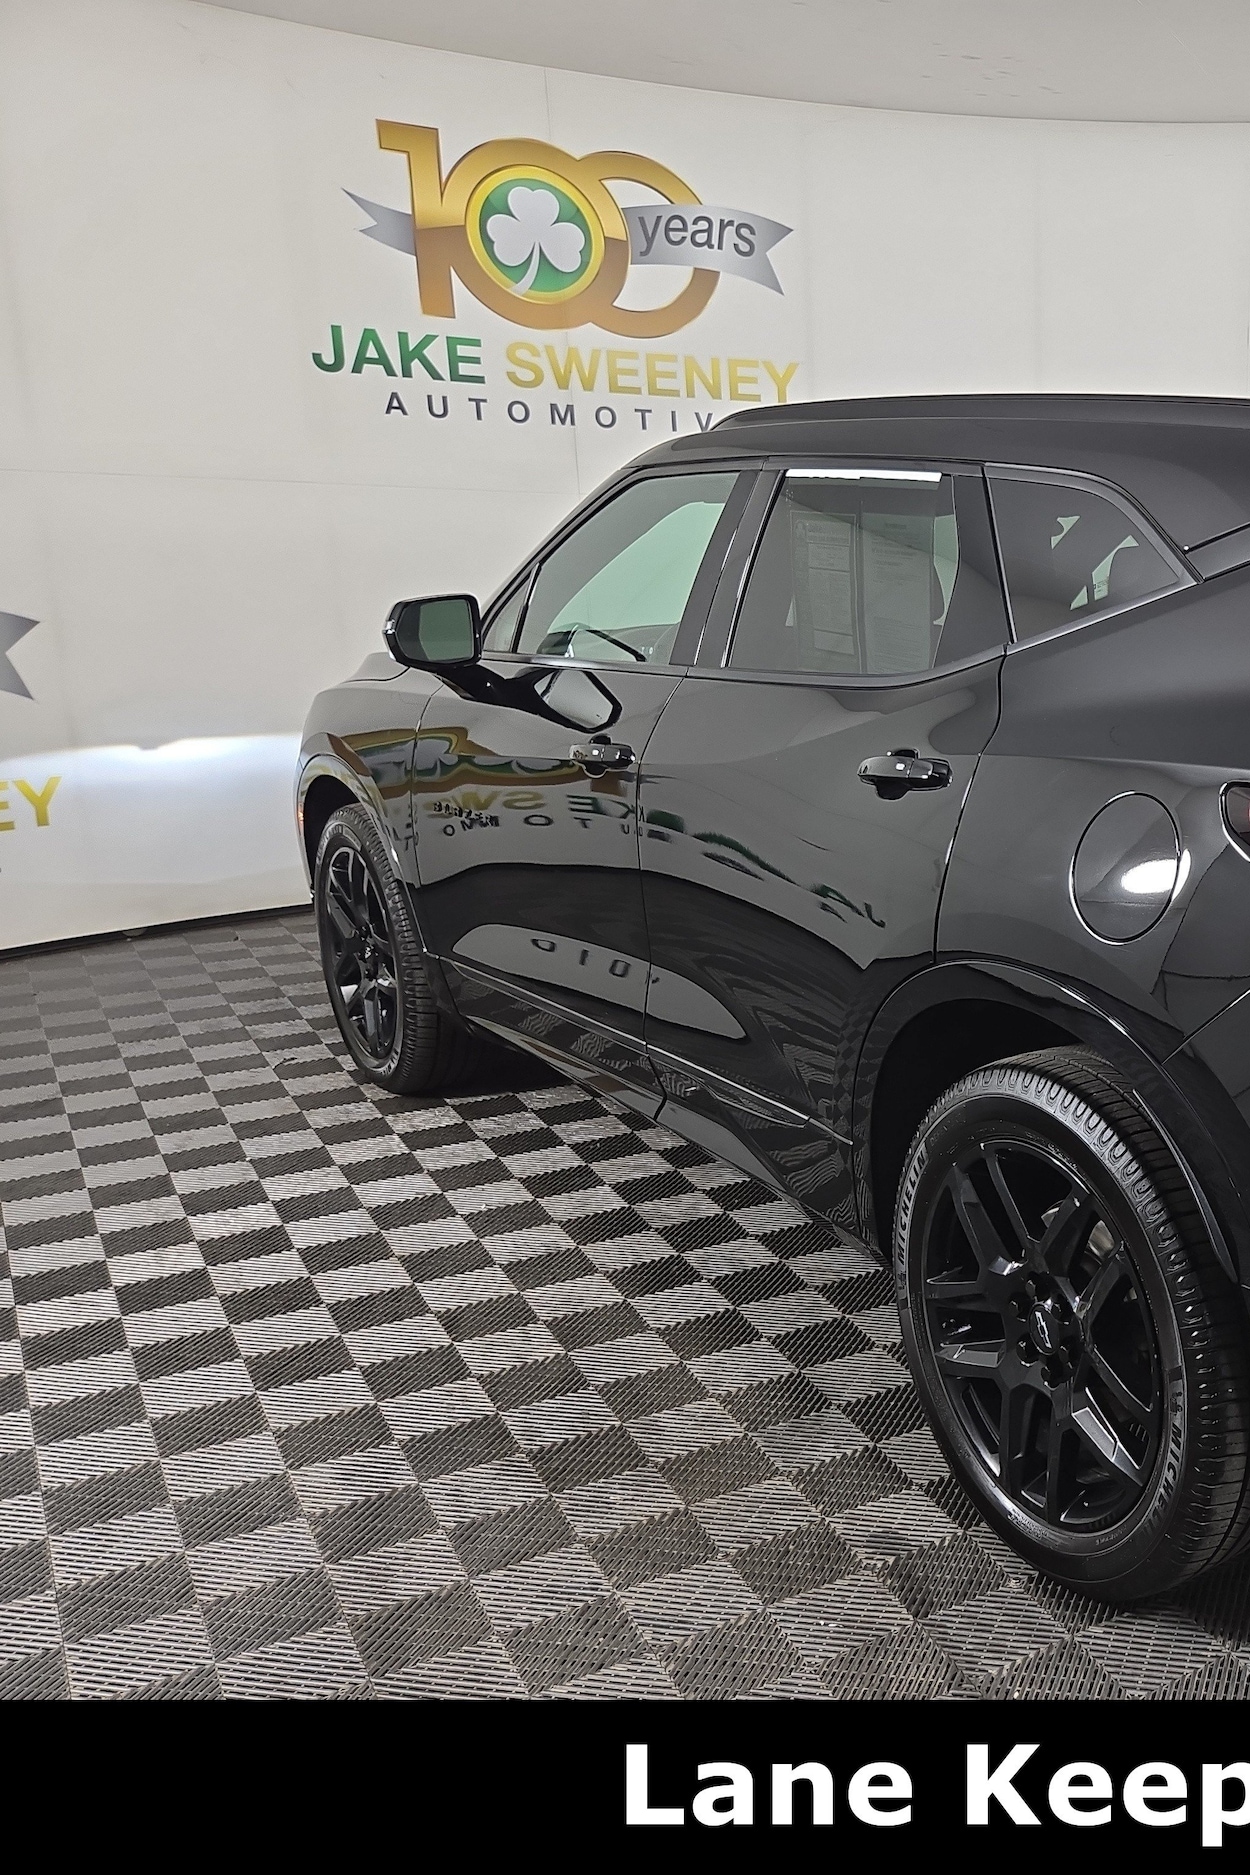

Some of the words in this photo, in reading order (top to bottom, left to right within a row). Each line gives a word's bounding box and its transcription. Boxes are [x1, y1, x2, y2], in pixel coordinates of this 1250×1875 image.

[376, 118, 721, 339] 100
[638, 214, 756, 257] years
[311, 324, 487, 385] JAKE
[505, 341, 800, 403] SWEENEY
[385, 391, 714, 433] AUTOMOTIV
[896, 1147, 927, 1266] MICHELIN
